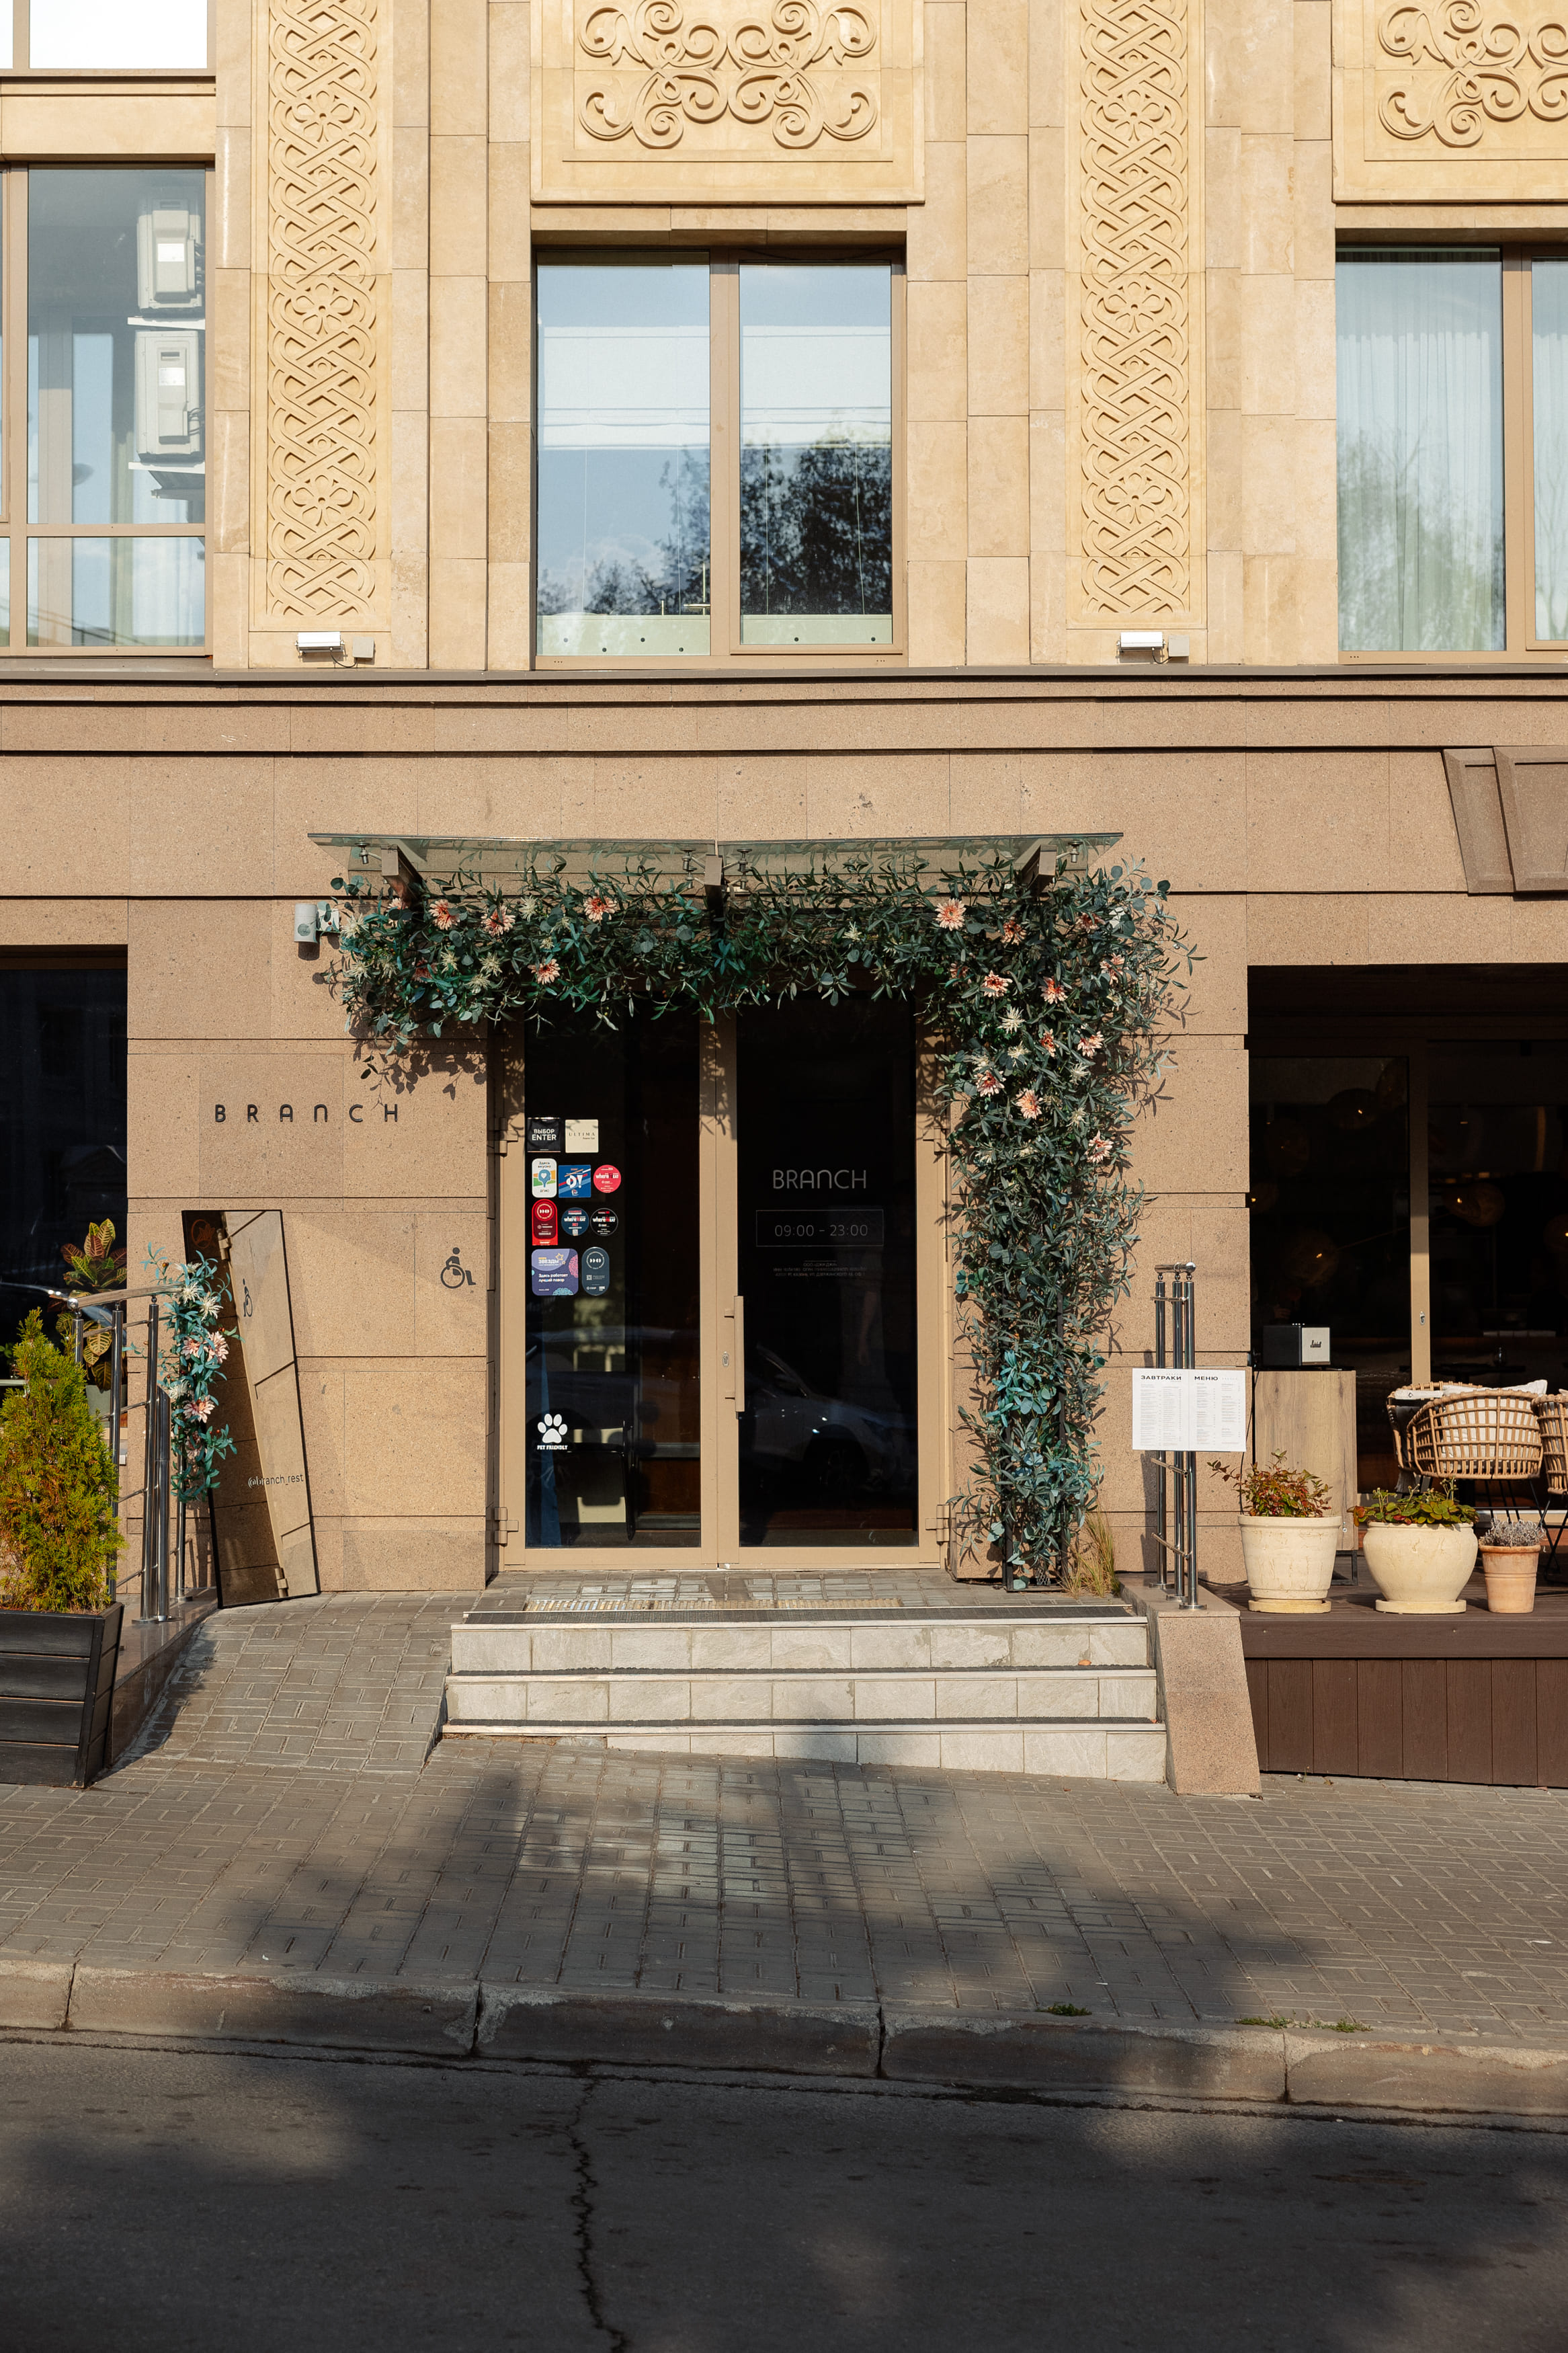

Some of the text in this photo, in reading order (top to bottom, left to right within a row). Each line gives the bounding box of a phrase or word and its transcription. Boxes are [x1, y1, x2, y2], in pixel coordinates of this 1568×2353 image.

[214, 1104, 398, 1123] BRANCH
[773, 1170, 866, 1189] BRANCH
[774, 1225, 815, 1237] 09:00
[829, 1224, 868, 1236] 23:00
[247, 1473, 304, 1490] @branch_rest
